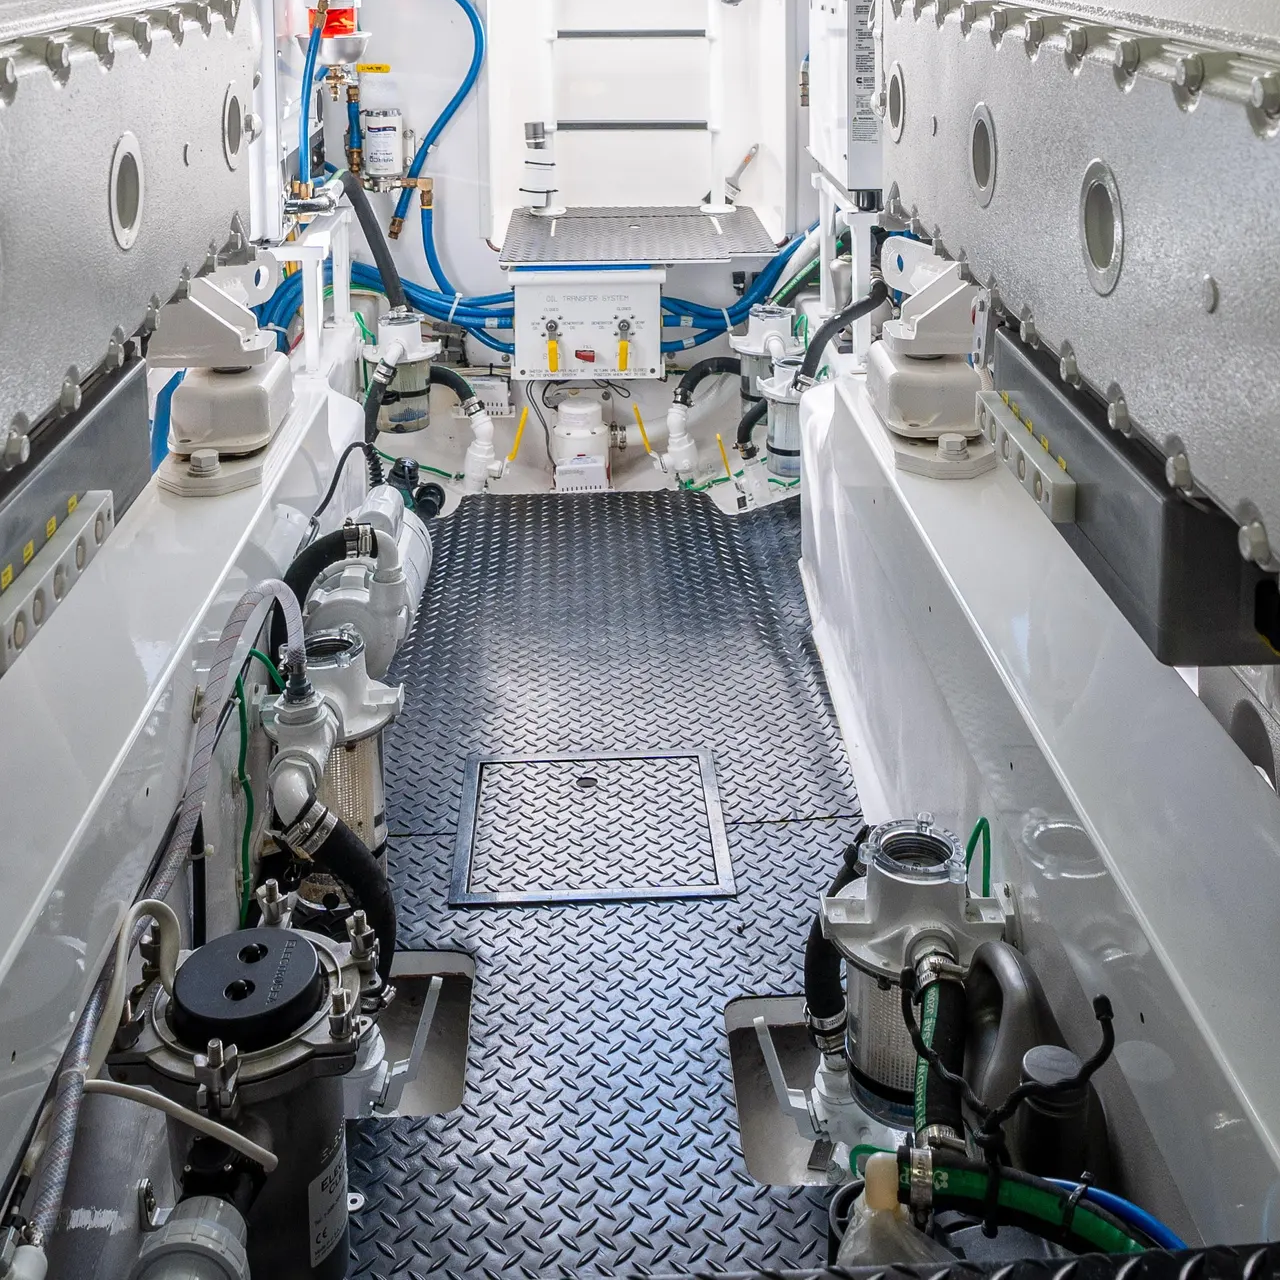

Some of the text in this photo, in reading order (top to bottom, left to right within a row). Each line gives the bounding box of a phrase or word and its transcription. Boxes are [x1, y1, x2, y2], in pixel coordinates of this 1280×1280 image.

[546, 294, 629, 303] OIL TRANSFER SYSTEM
[542, 352, 561, 360] SD
[614, 351, 632, 359] PT
[266, 939, 297, 1006] ELECTROSEA
[926, 986, 936, 1015] J2006
[923, 1017, 933, 1041] SAE
